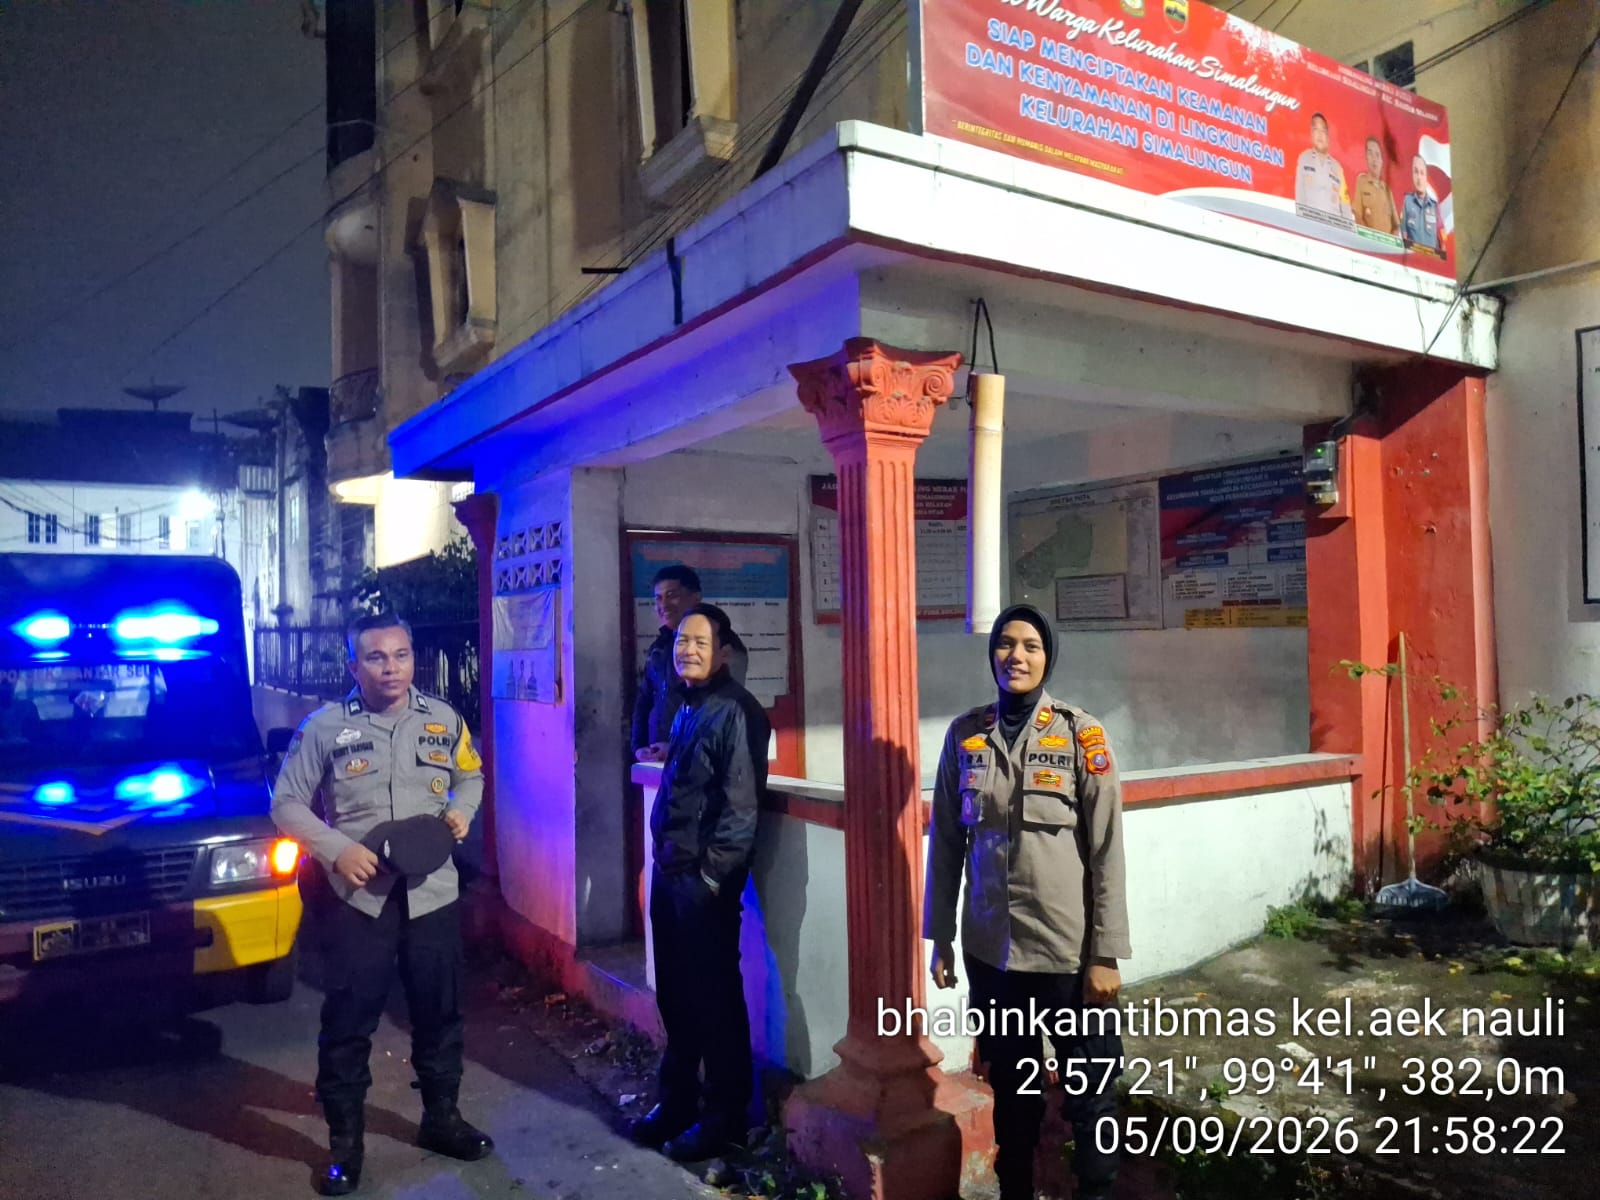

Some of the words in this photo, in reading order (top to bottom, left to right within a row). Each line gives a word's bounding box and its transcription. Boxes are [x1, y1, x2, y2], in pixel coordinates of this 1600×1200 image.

[965, 42, 1013, 77] DAN
[1019, 60, 1151, 122] KENYAMANAN
[1156, 107, 1175, 130] DI
[1179, 115, 1285, 167] LINGKUNGAN
[988, 18, 1035, 51] SIAP
[1040, 37, 1173, 100] MENCIPTAKAN
[1177, 86, 1267, 135] KEAMANAN
[1098, 18, 1197, 71] Kelurahan
[1196, 56, 1300, 112] Simalungun
[1020, 93, 1138, 147] KELURAHAN
[1143, 131, 1253, 183] SIMALUNGUN
[1028, 752, 1072, 767] POLRI
